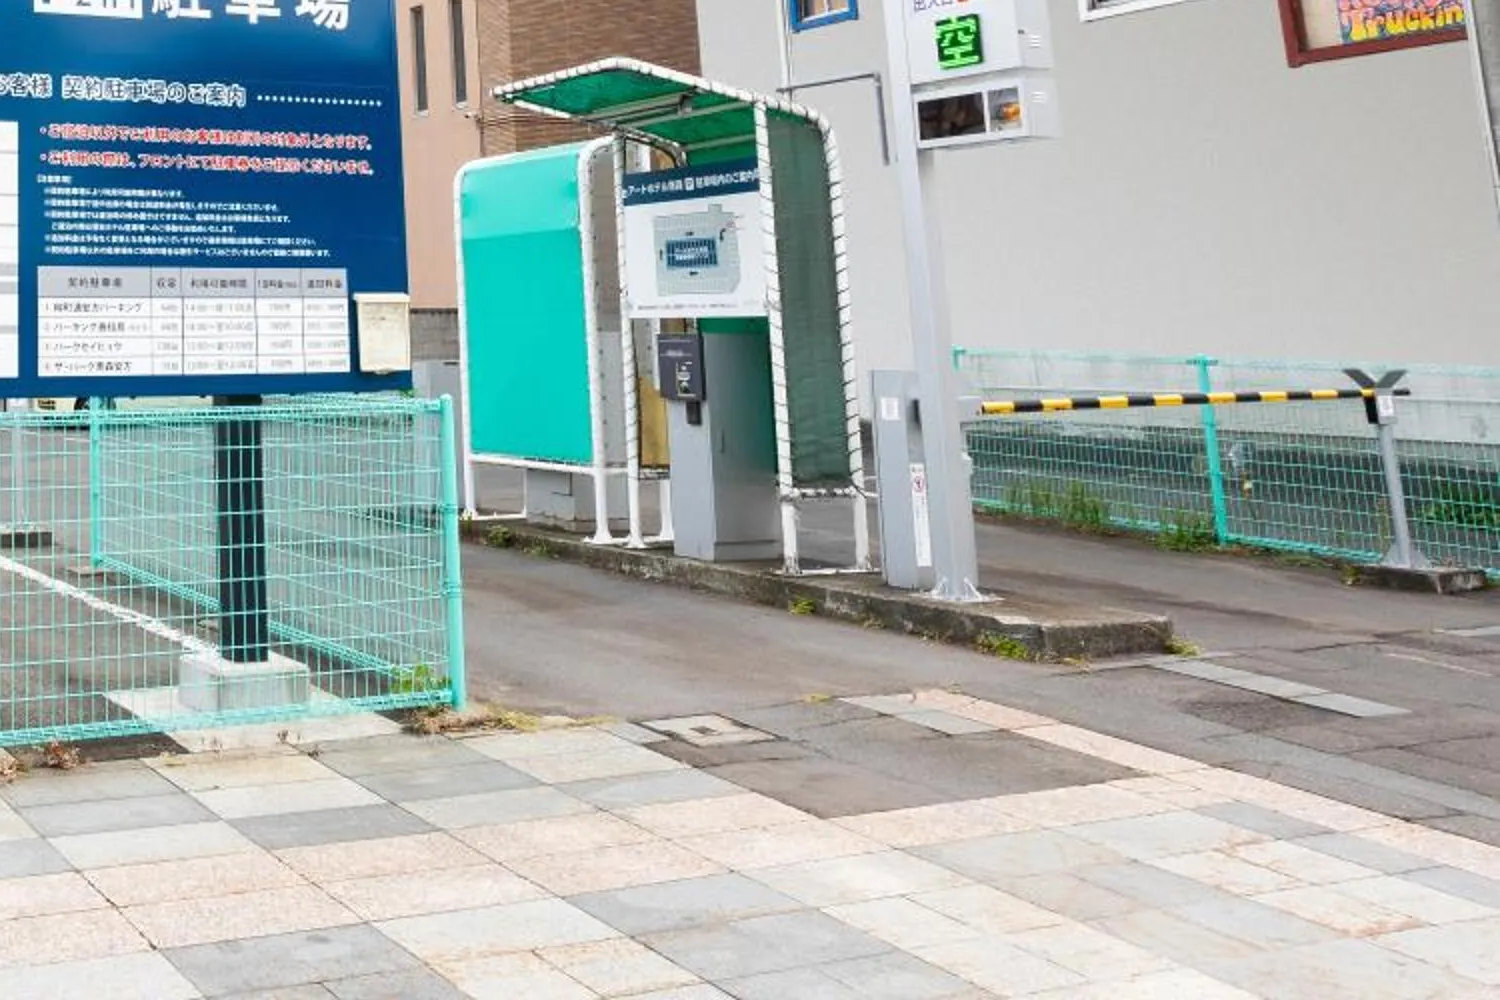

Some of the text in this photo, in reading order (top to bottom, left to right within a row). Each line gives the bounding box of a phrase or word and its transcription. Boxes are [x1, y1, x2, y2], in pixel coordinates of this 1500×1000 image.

[935, 14, 981, 70] 空
[62, 75, 247, 108] 契約駐車場のご案内
